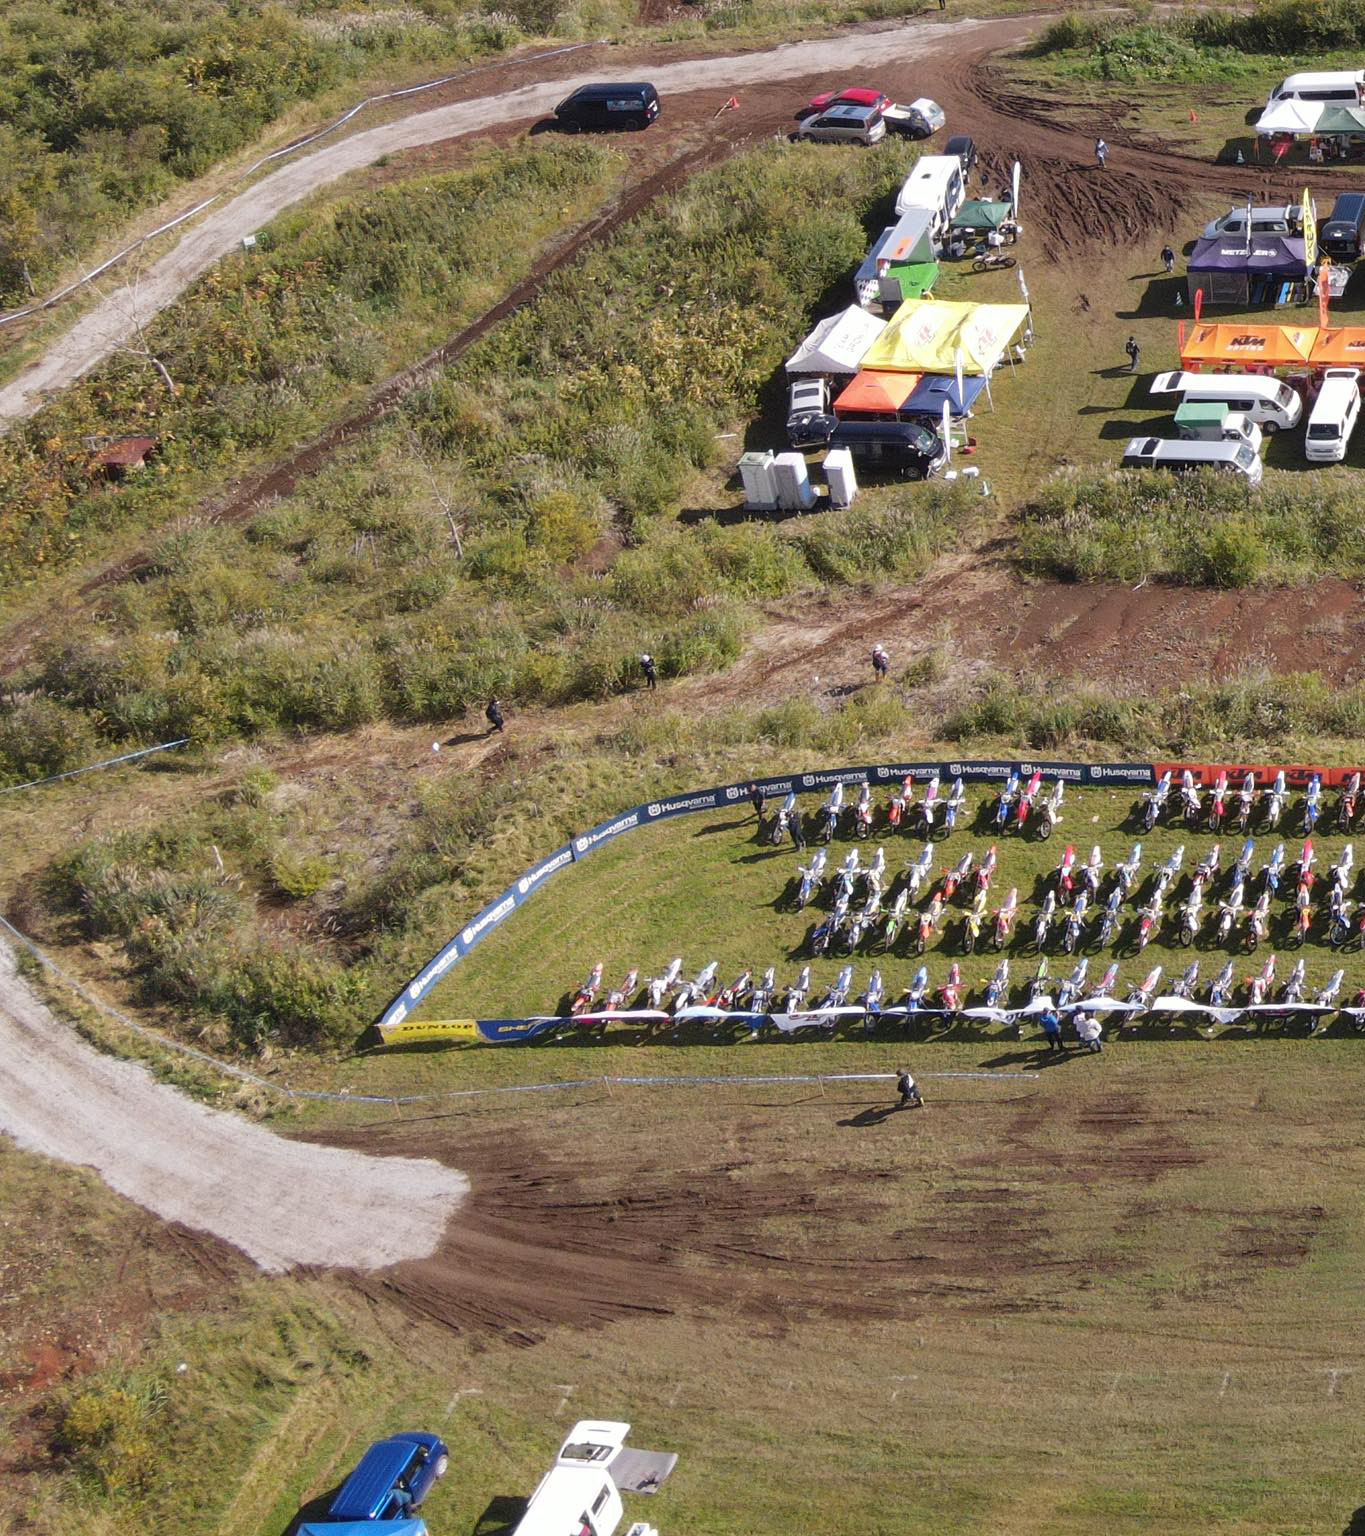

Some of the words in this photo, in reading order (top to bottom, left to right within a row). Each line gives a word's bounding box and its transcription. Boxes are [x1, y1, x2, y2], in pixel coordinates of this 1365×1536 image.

[1231, 335, 1266, 345] KTM
[891, 767, 941, 777] Husqvarna
[962, 766, 1012, 775] Husqvarna
[1033, 766, 1082, 776] Husqvarna
[1102, 768, 1151, 779] Husqvarna
[816, 771, 868, 784] Husqvarna
[740, 781, 792, 796] Hqvarna
[661, 794, 716, 812] Husqvarna
[587, 813, 638, 844] Husqvarna
[402, 1023, 473, 1032] DUNLOP
